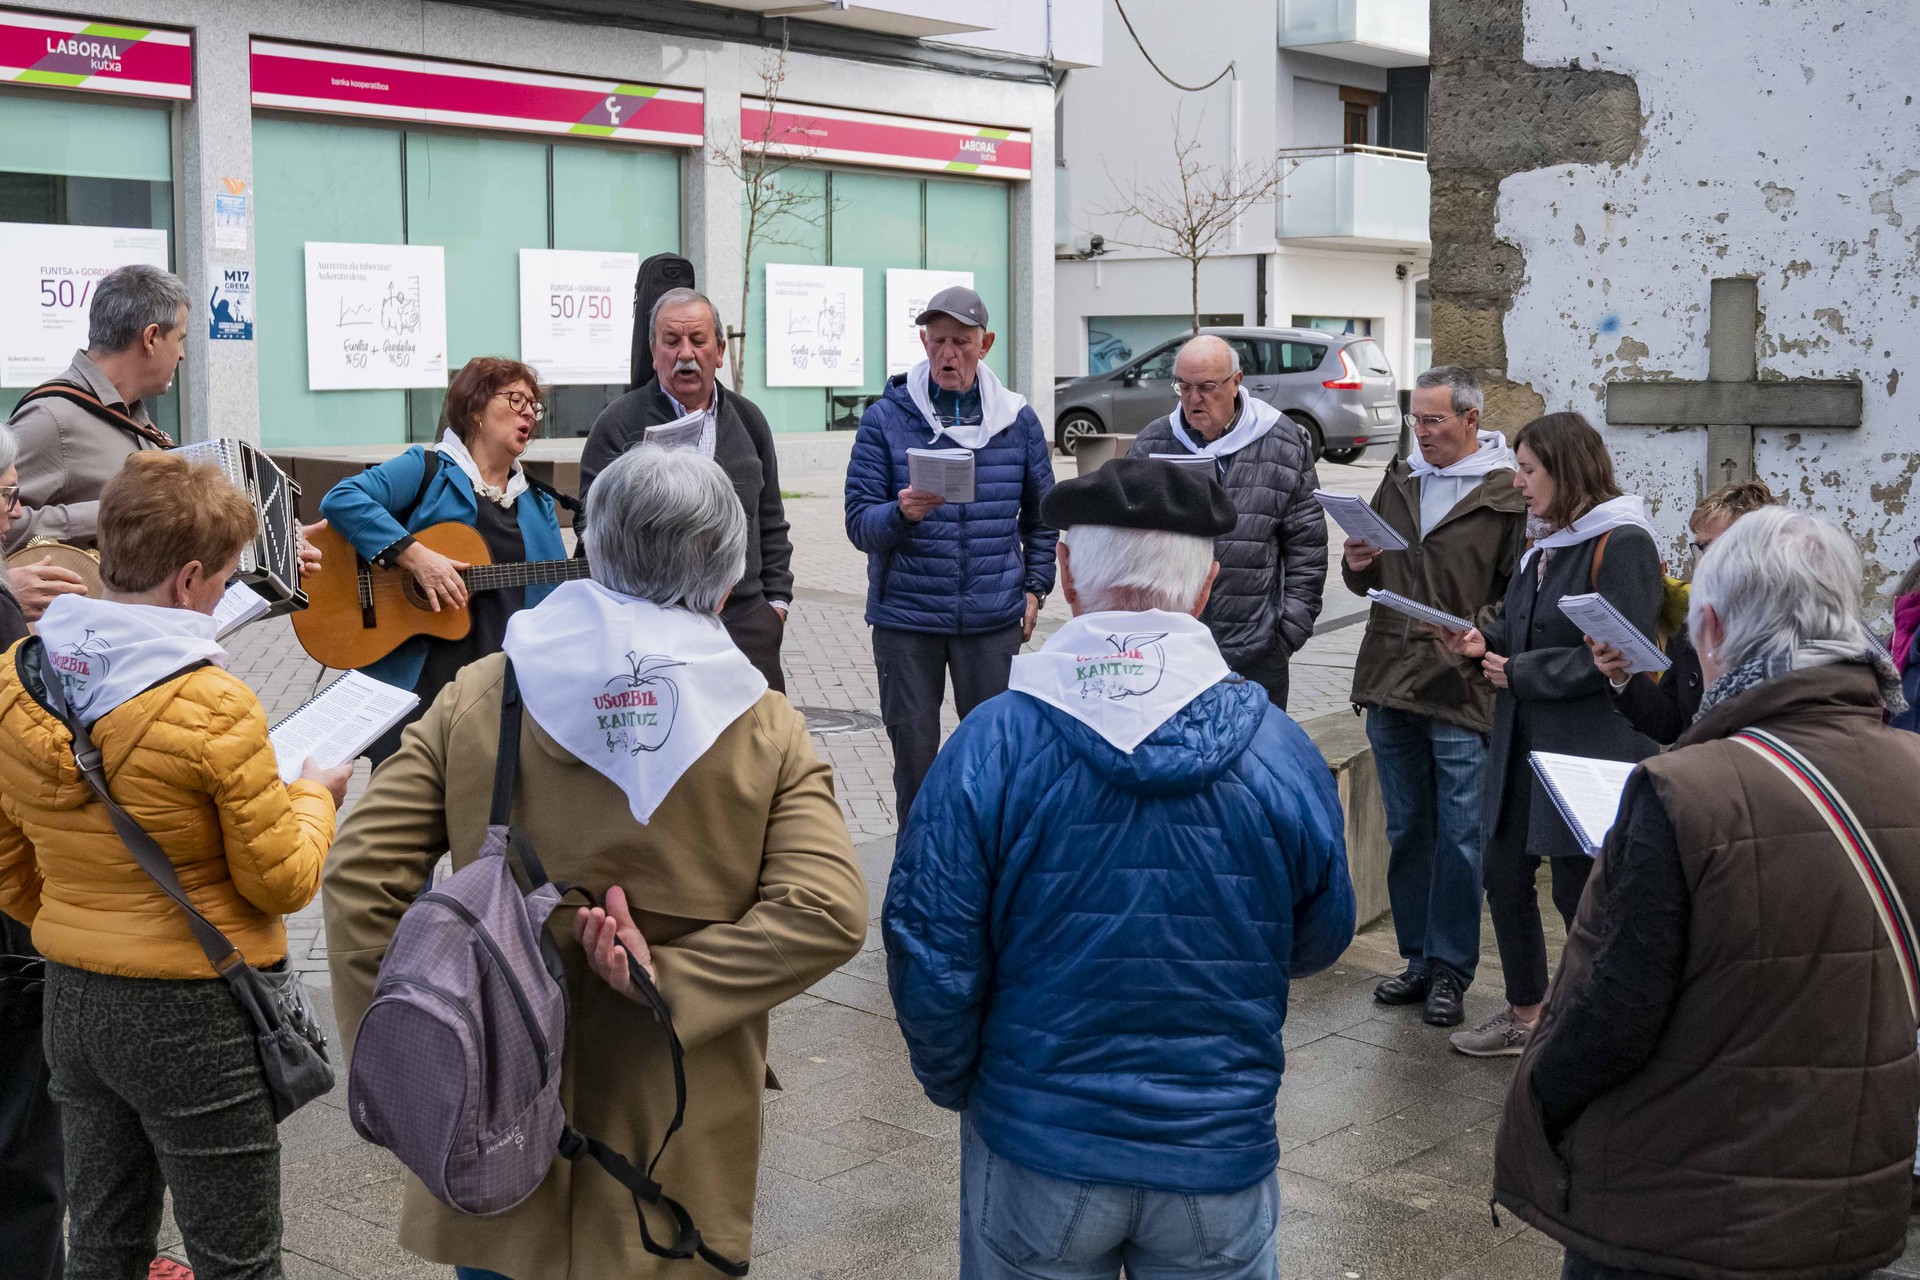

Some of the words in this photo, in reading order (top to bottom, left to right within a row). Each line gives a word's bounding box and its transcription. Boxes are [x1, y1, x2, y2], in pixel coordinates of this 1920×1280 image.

[46, 37, 121, 61] LABORAL
[90, 58, 122, 73] kutxa
[331, 77, 350, 87] banka
[960, 138, 997, 154] LABORAL
[40, 266, 74, 276] FUNTSA
[224, 270, 250, 282] M17
[224, 282, 250, 290] GREBA
[550, 284, 574, 292] FUNTSA
[578, 285, 612, 293] GORDAILUA
[1075, 661, 1144, 680] KANTUZ
[593, 689, 658, 710] USURBIL
[597, 711, 658, 730] KANTUZ
